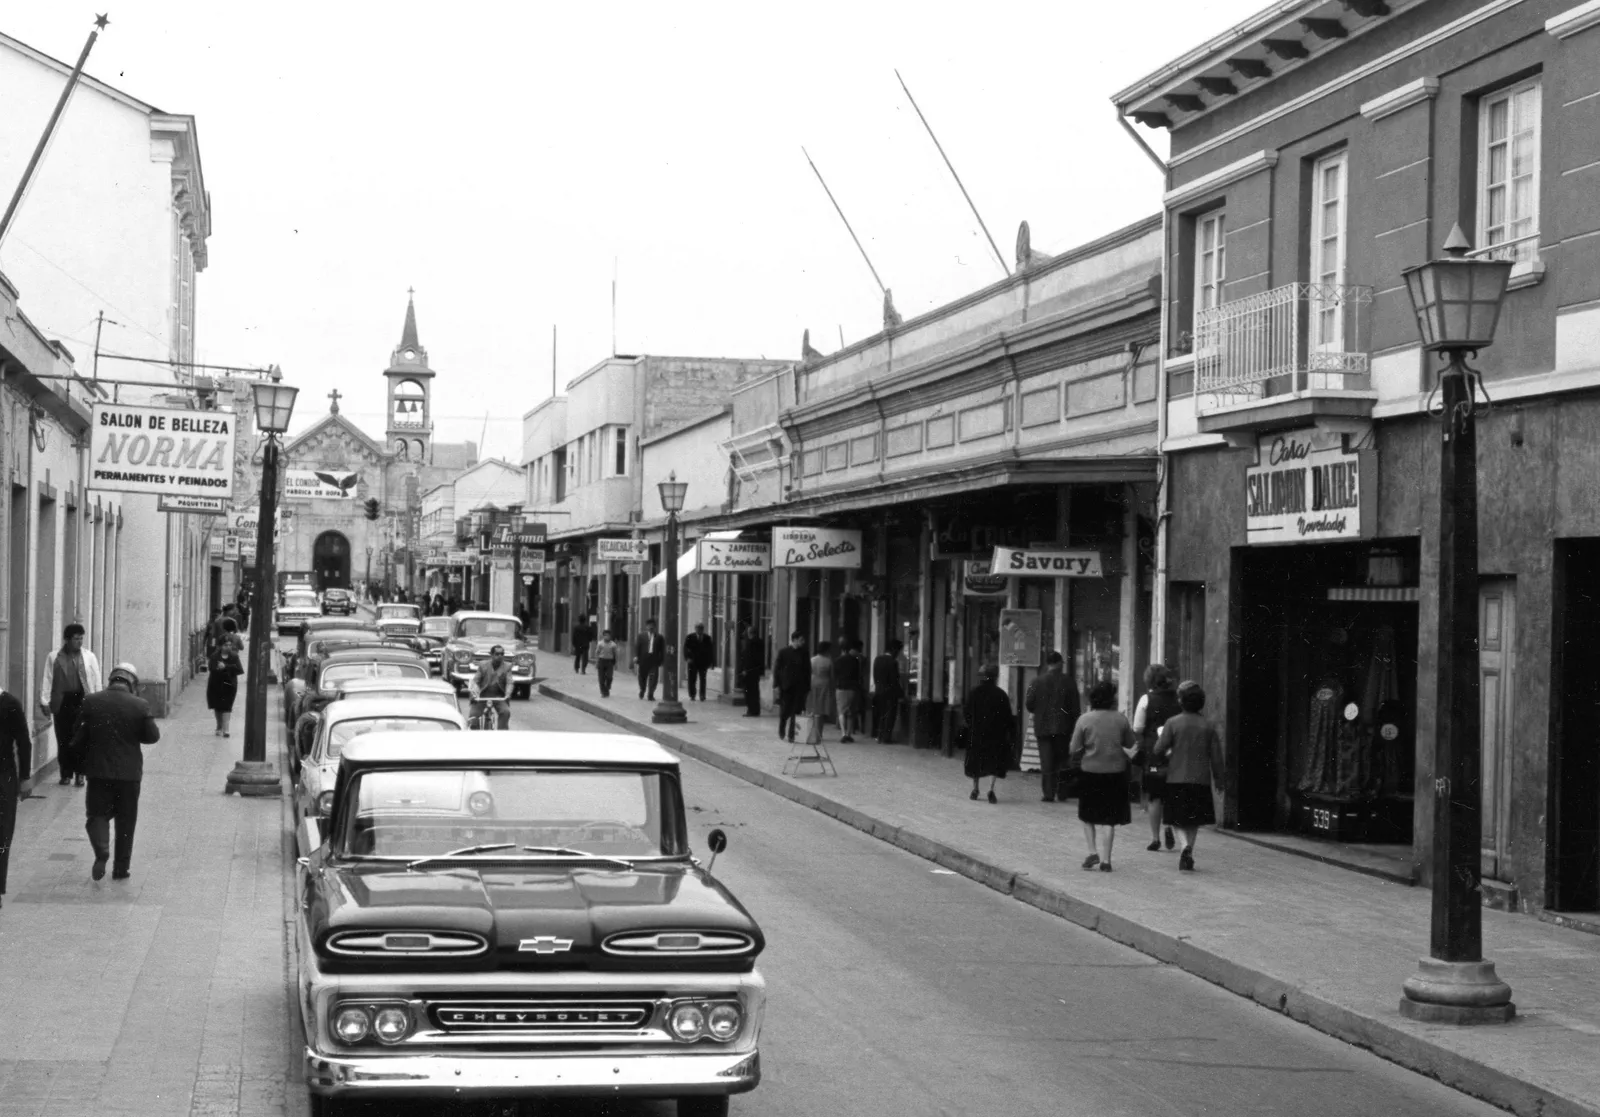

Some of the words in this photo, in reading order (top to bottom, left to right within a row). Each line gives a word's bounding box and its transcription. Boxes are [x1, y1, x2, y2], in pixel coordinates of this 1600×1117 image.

[100, 412, 142, 428] SALON
[149, 416, 165, 430] DE
[172, 418, 229, 434] BELLEZA
[98, 432, 227, 471] NORMA
[1270, 436, 1311, 466] Casa
[94, 470, 166, 484] PERMANENTES
[169, 476, 176, 484] Y
[178, 476, 228, 488] PEINADOS
[286, 478, 294, 487] EL
[295, 478, 321, 488] CONDOR
[178, 500, 219, 508] PAQUETERIA
[728, 544, 768, 553] ZAPATERIA
[785, 547, 805, 566] La
[807, 540, 856, 561] Selecta
[707, 554, 721, 566] La
[1010, 551, 1092, 575] Savory
[453, 1013, 630, 1022] CHEVROLET
